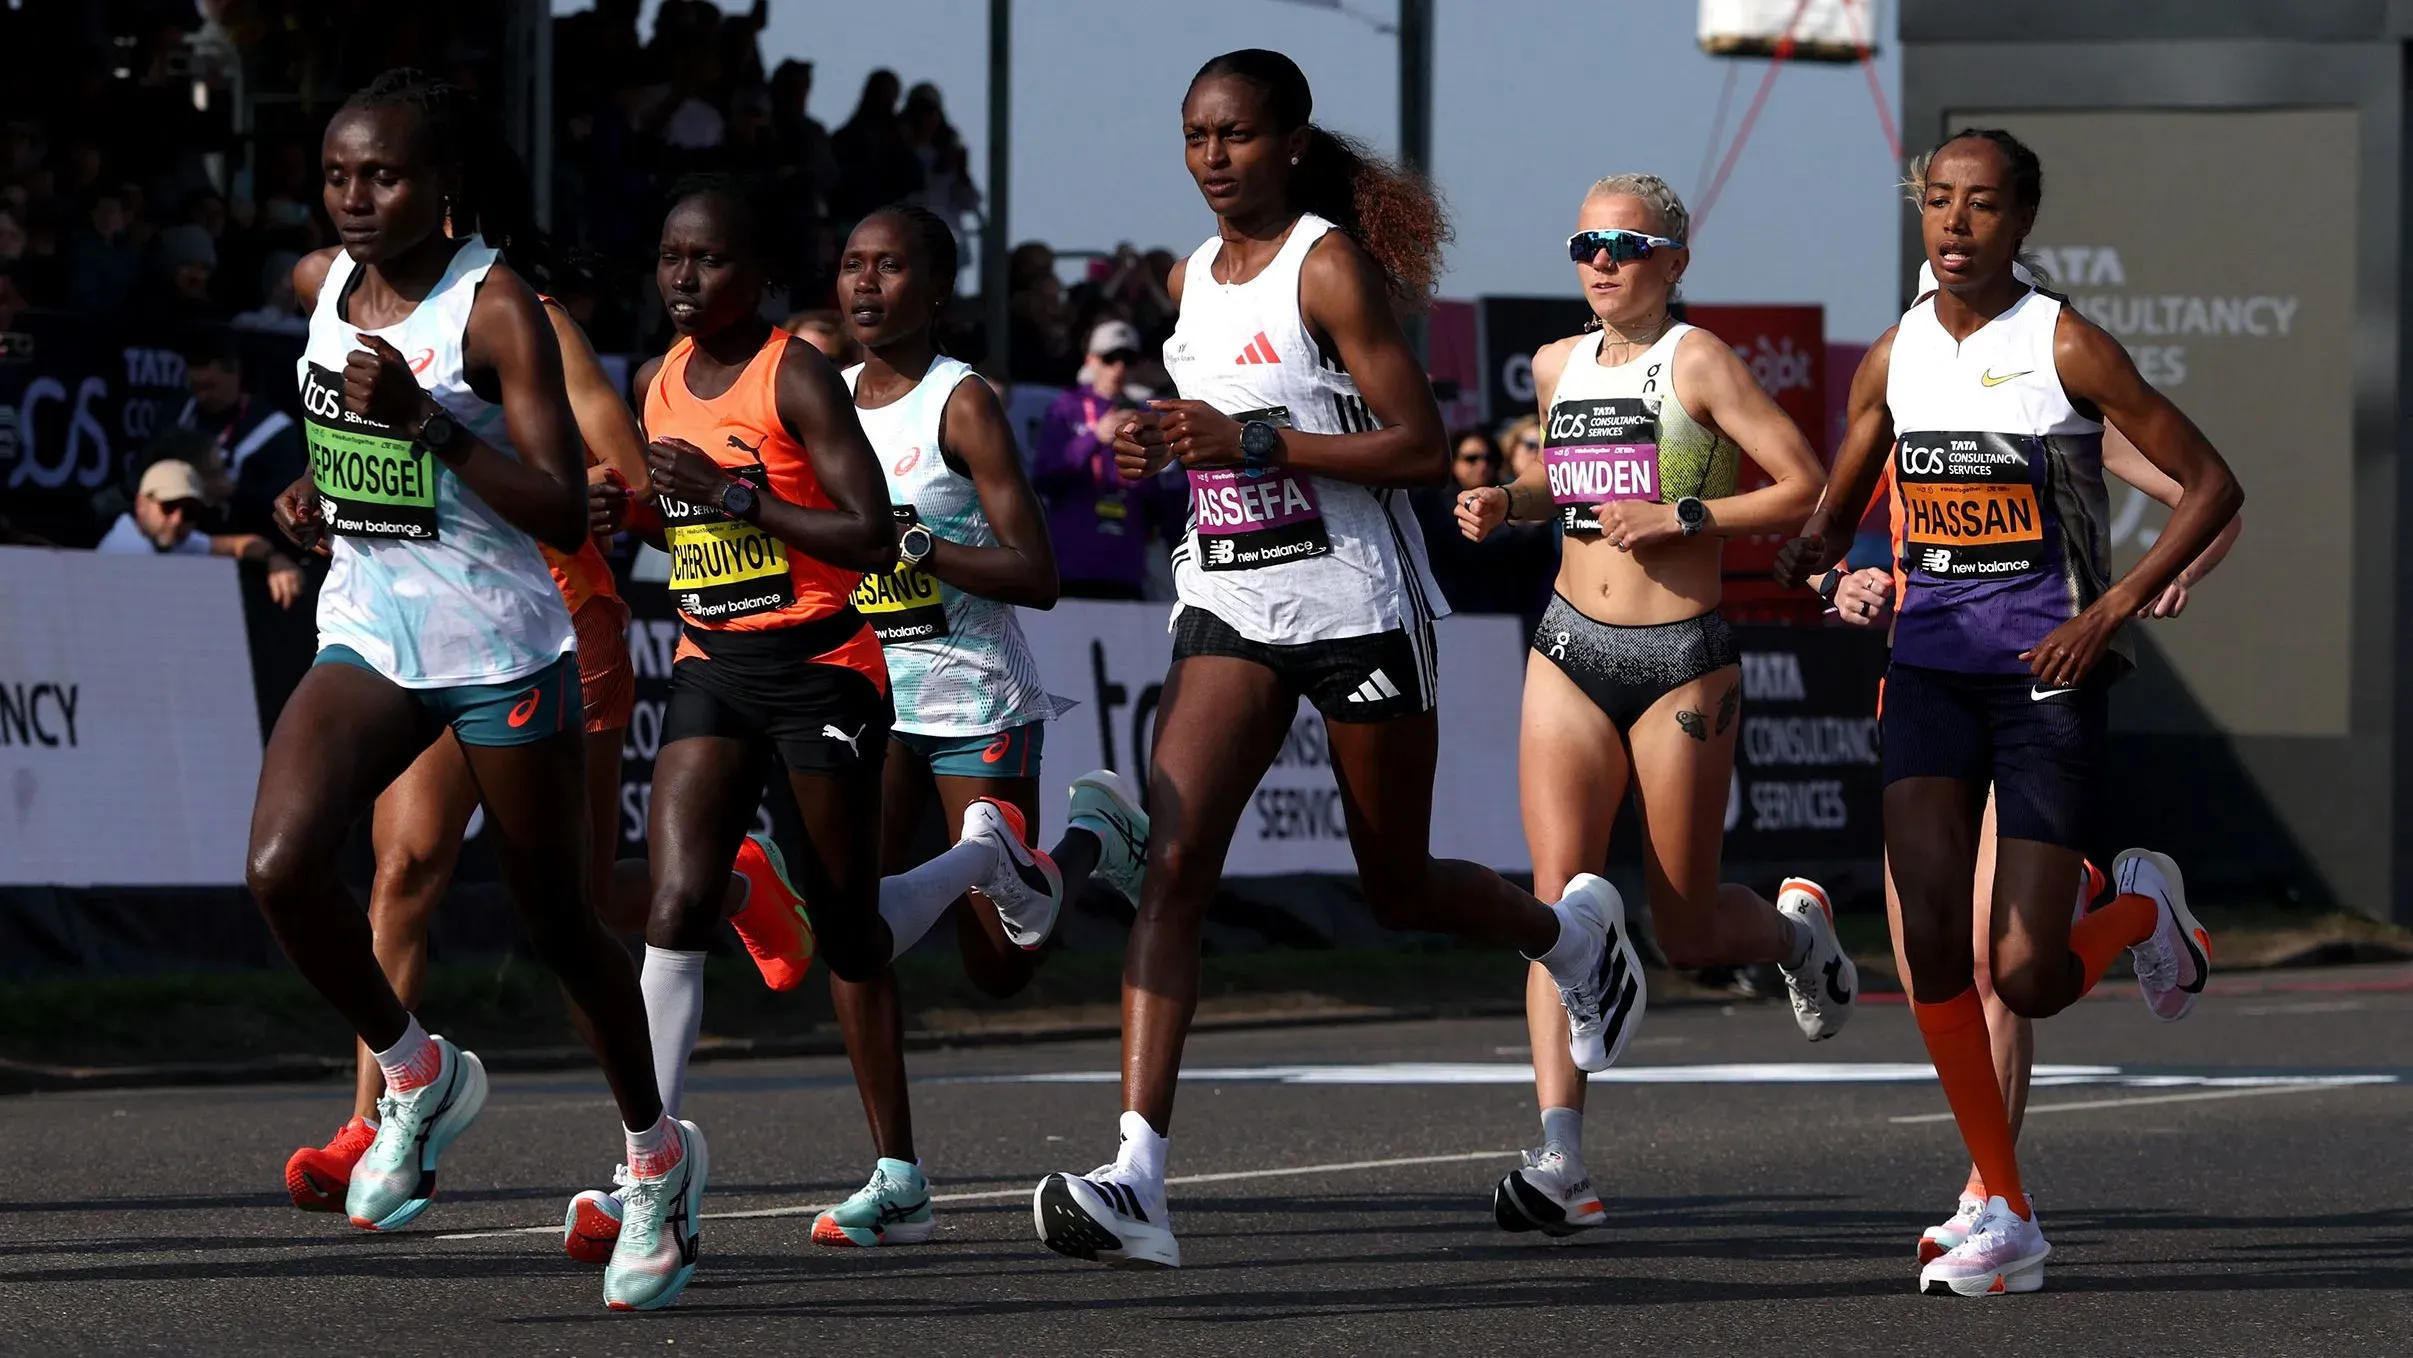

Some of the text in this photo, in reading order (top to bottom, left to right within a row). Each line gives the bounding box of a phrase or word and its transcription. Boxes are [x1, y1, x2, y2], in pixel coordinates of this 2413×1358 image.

[304, 374, 340, 419] tcs
[1592, 406, 1616, 416] TATA
[1551, 410, 1588, 439] tcs
[1588, 426, 1623, 437] SERVICES
[1590, 415, 1646, 427] CONSULTANCY
[1901, 440, 1945, 474] tcs
[1948, 452, 2018, 465] CONSULTANCY
[1950, 440, 1978, 451] TATA
[1548, 460, 1652, 497] BOWDEN
[1948, 465, 1992, 476] SERVICES
[1198, 477, 1312, 527] ASSEFA
[337, 518, 422, 534] new balance
[1911, 498, 2033, 537] HASSAN
[673, 535, 777, 581] CHERUIYOT
[1237, 540, 1313, 563] new balance
[1952, 560, 2030, 574] new balance
[849, 567, 932, 606] ESANG
[702, 592, 781, 617] new balance
[888, 624, 933, 639] balance
[0, 682, 79, 748] NCY
[1744, 716, 1881, 764] CONSULTANC
[1256, 786, 1347, 840] SERVIC
[1750, 780, 1847, 831] SERVICES
